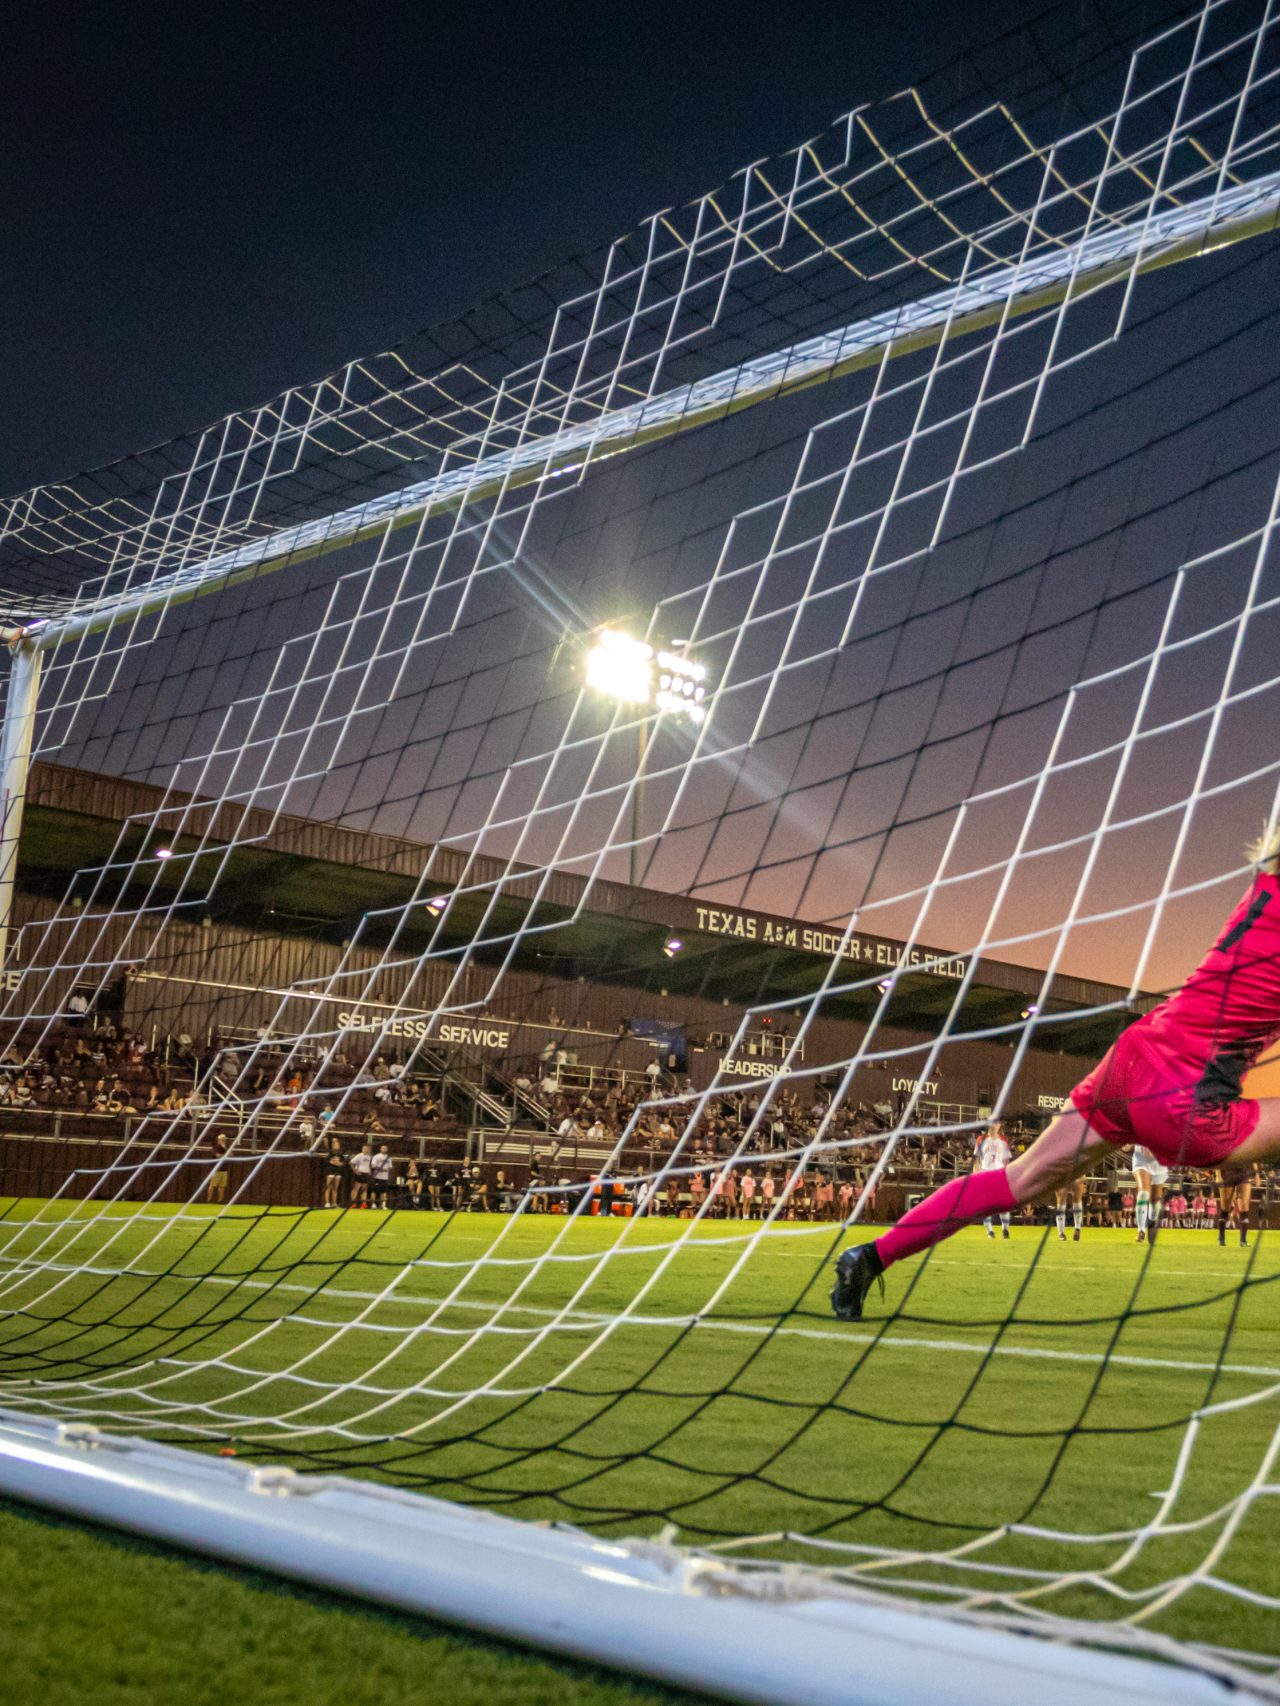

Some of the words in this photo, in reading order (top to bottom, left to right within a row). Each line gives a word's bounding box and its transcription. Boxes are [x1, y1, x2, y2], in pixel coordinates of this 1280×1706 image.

[697, 908, 757, 939] TEXAS
[763, 922, 797, 947] A&M
[803, 929, 860, 960] SOCCER
[877, 944, 920, 969] ELLIS
[924, 954, 965, 979] FIELD
[336, 1012, 427, 1038] SELFLESS
[439, 1025, 509, 1048] SERVICE
